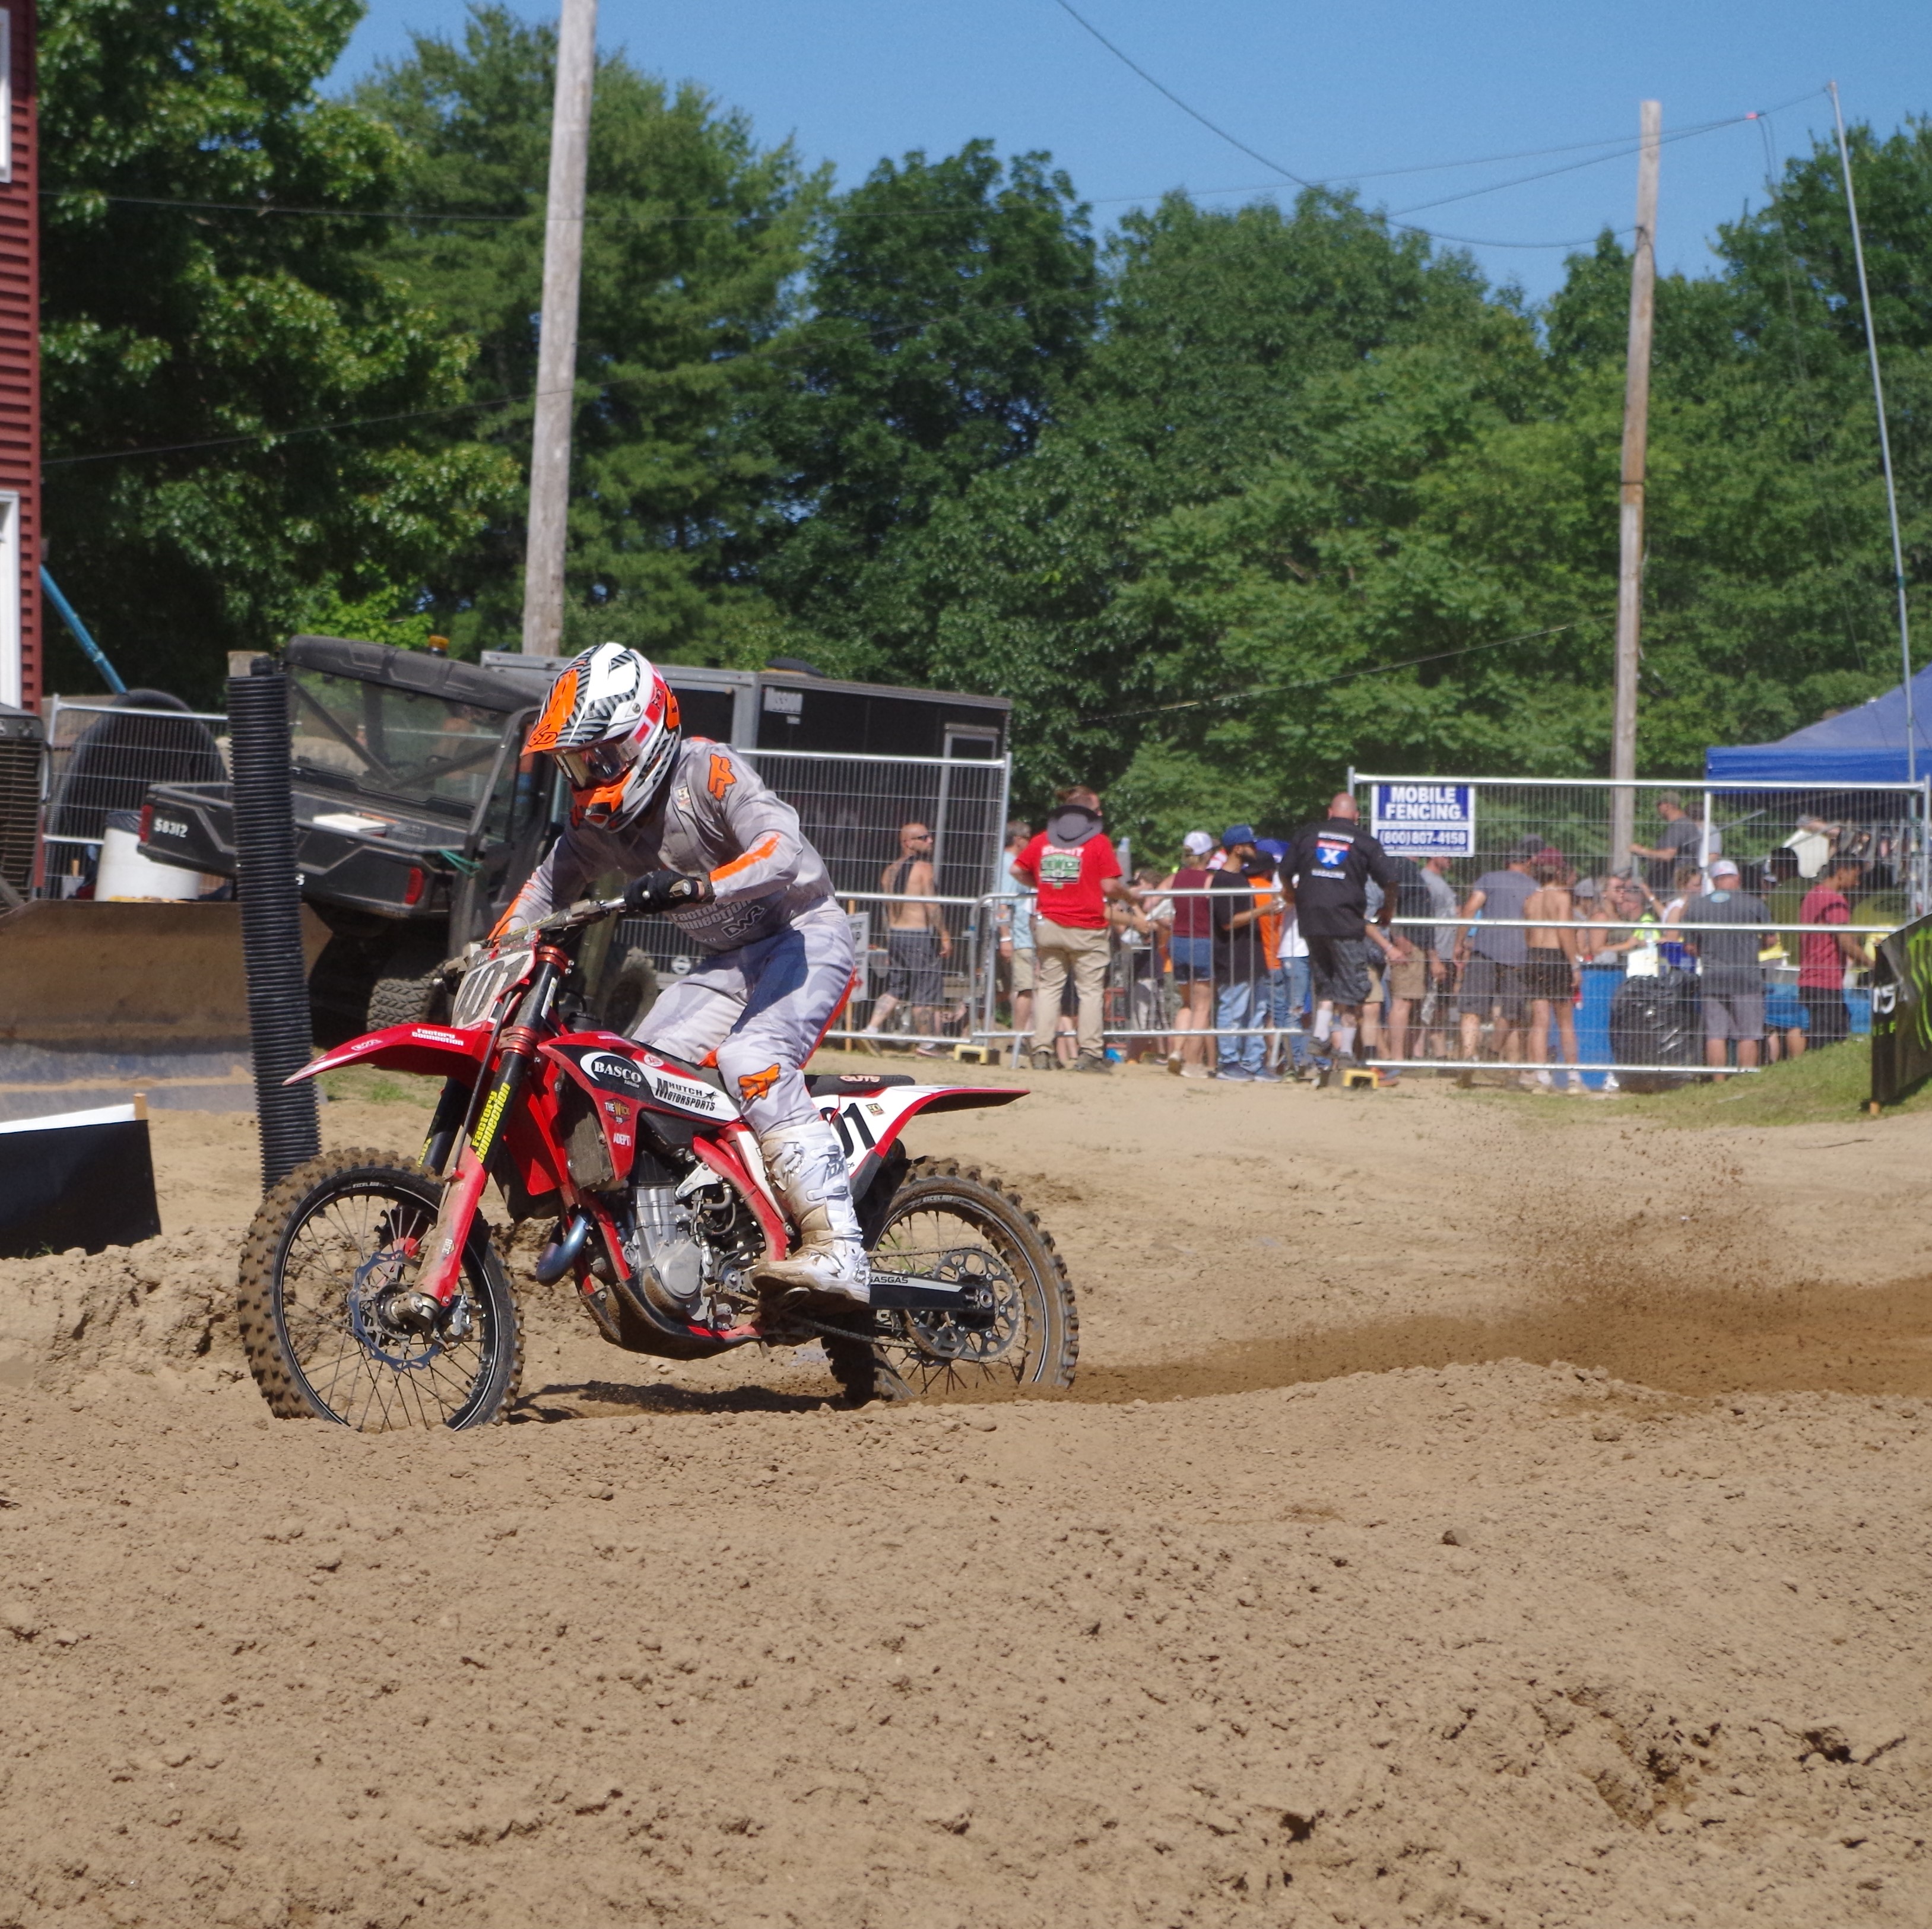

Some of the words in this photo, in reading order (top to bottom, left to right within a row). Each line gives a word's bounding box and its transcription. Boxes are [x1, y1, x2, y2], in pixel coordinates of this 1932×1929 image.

[1390, 786, 1456, 804] MOBILE
[1385, 804, 1461, 820] FENCING
[721, 905, 766, 939] DWR
[594, 1061, 642, 1084] BASCO
[839, 1074, 881, 1083] GUTS
[655, 1077, 715, 1111] MOTORSPORTS
[668, 1081, 703, 1096] HUTCH
[605, 1102, 615, 1112] THE
[613, 1132, 632, 1147] ADEPT
